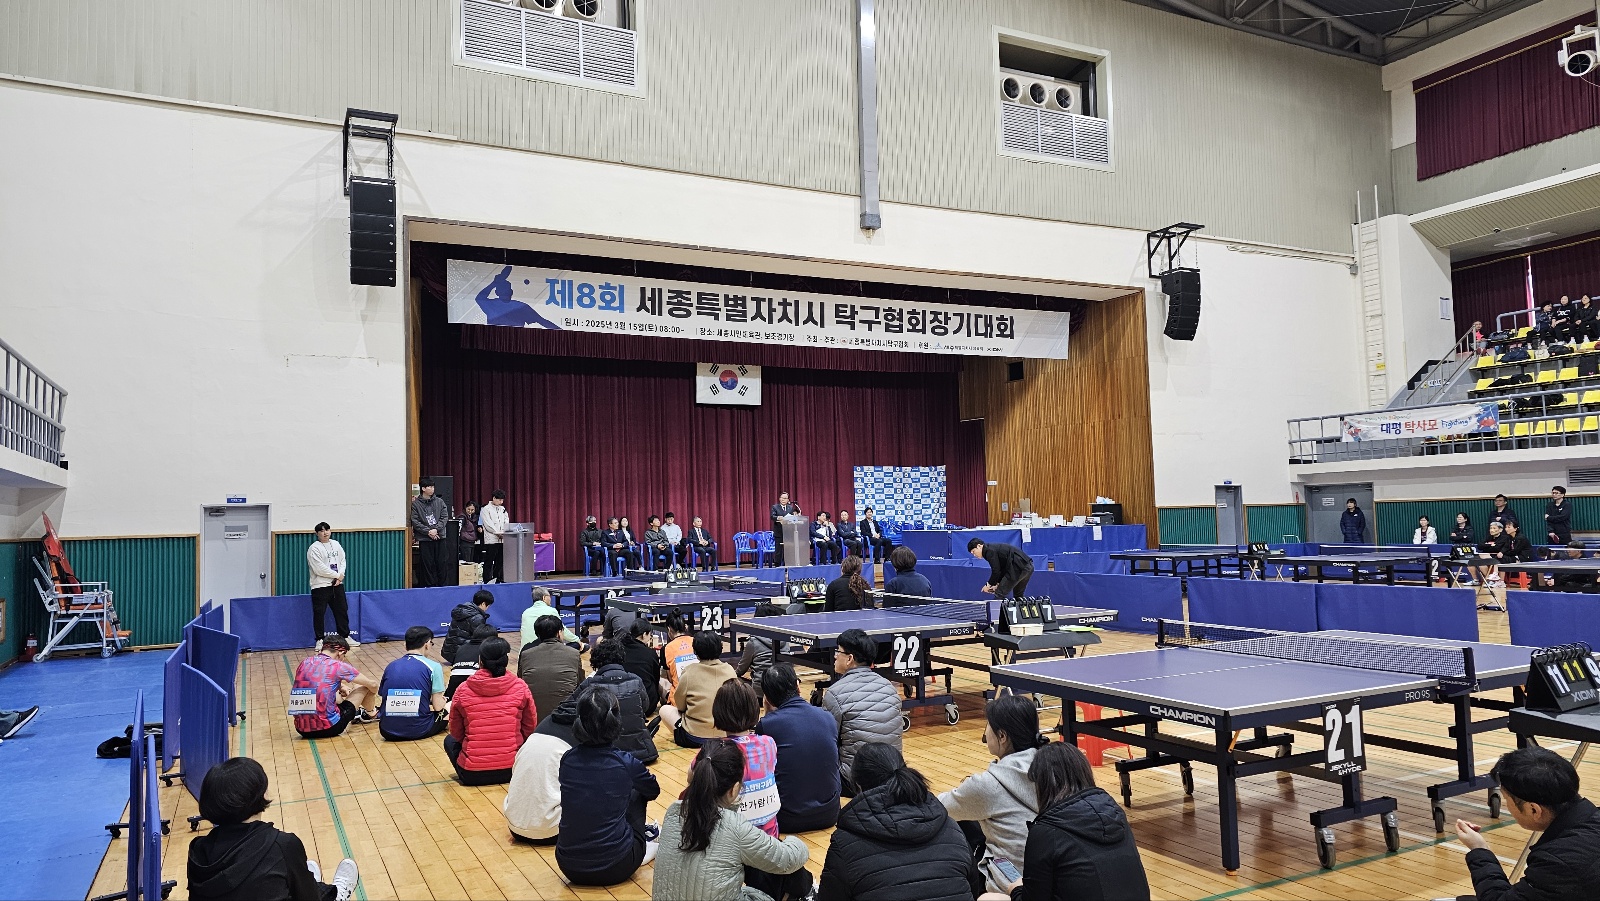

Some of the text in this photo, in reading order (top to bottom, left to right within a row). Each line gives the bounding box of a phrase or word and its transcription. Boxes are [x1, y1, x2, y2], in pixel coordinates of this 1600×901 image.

[545, 277, 1015, 340] 제8회 세종특별자치시 탁구협회장기대회
[564, 317, 579, 327] 일시
[585, 319, 612, 330] 2025년
[1380, 421, 1402, 435] 대평
[1404, 419, 1439, 434] 탁사모
[690, 571, 697, 580] 7
[802, 583, 808, 592] 0
[809, 583, 815, 592] 0
[701, 606, 723, 632] 23
[1008, 604, 1052, 624] 7 1 1 7
[1078, 615, 1114, 624] CHAMPION
[949, 628, 962, 636] PRO
[789, 635, 814, 646] CHAMPION
[893, 635, 921, 670] 22
[1547, 657, 1600, 694] 11 1 1 9
[1405, 689, 1431, 702] PRO 95
[1571, 688, 1597, 703] XIOM
[1149, 705, 1216, 727] CHAMPION
[1325, 704, 1363, 764] 21
[1329, 761, 1357, 773] JEKYLL
